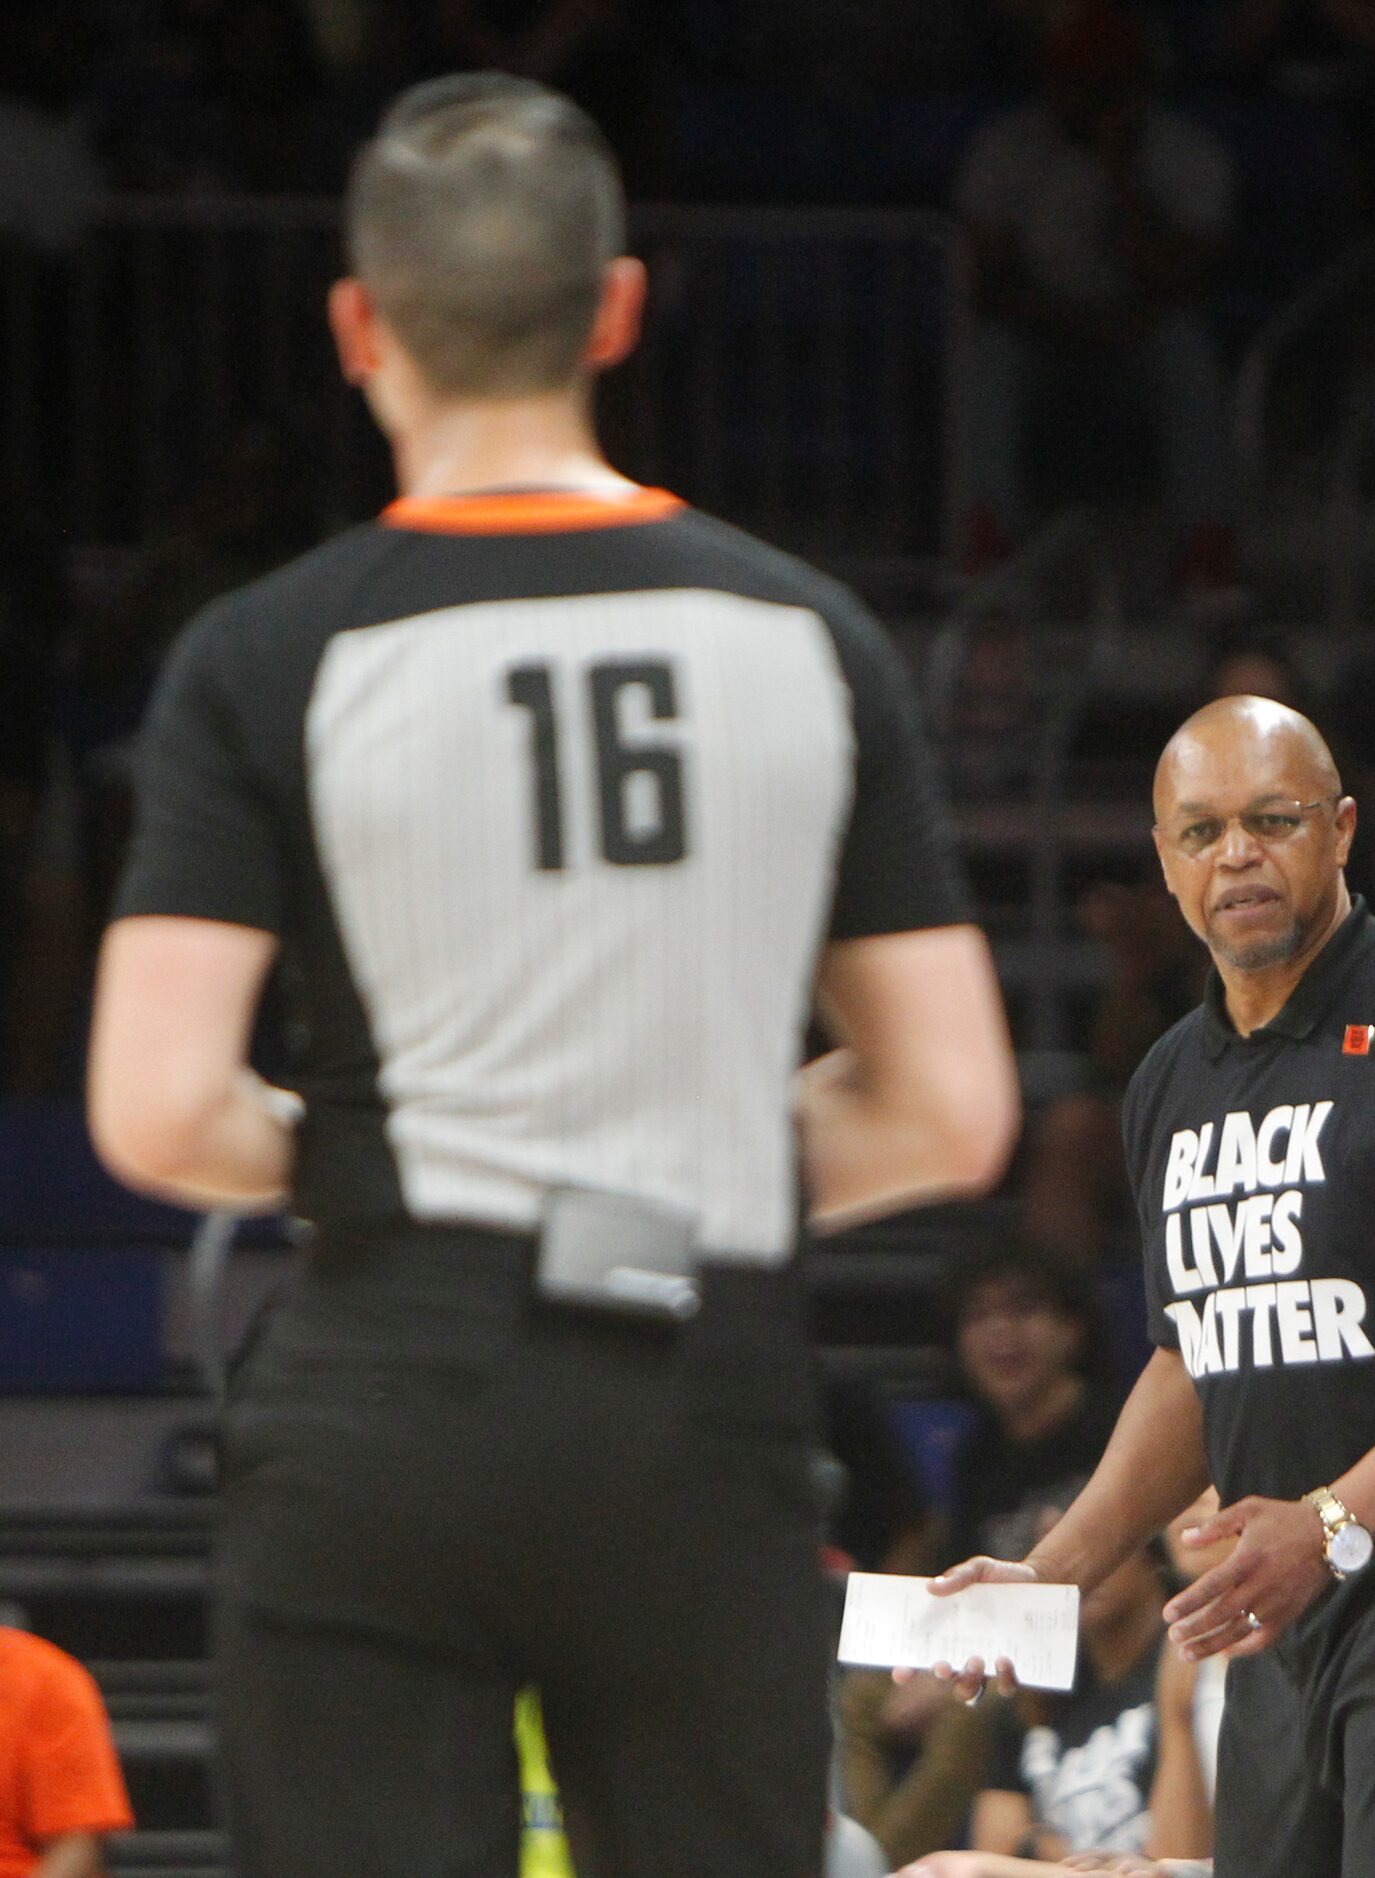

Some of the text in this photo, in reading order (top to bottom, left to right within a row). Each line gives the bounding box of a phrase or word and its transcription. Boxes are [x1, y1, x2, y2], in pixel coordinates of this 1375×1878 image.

[503, 660, 686, 872] 16
[1163, 1101, 1334, 1211] BLACK
[1165, 1191, 1303, 1294] LIVES
